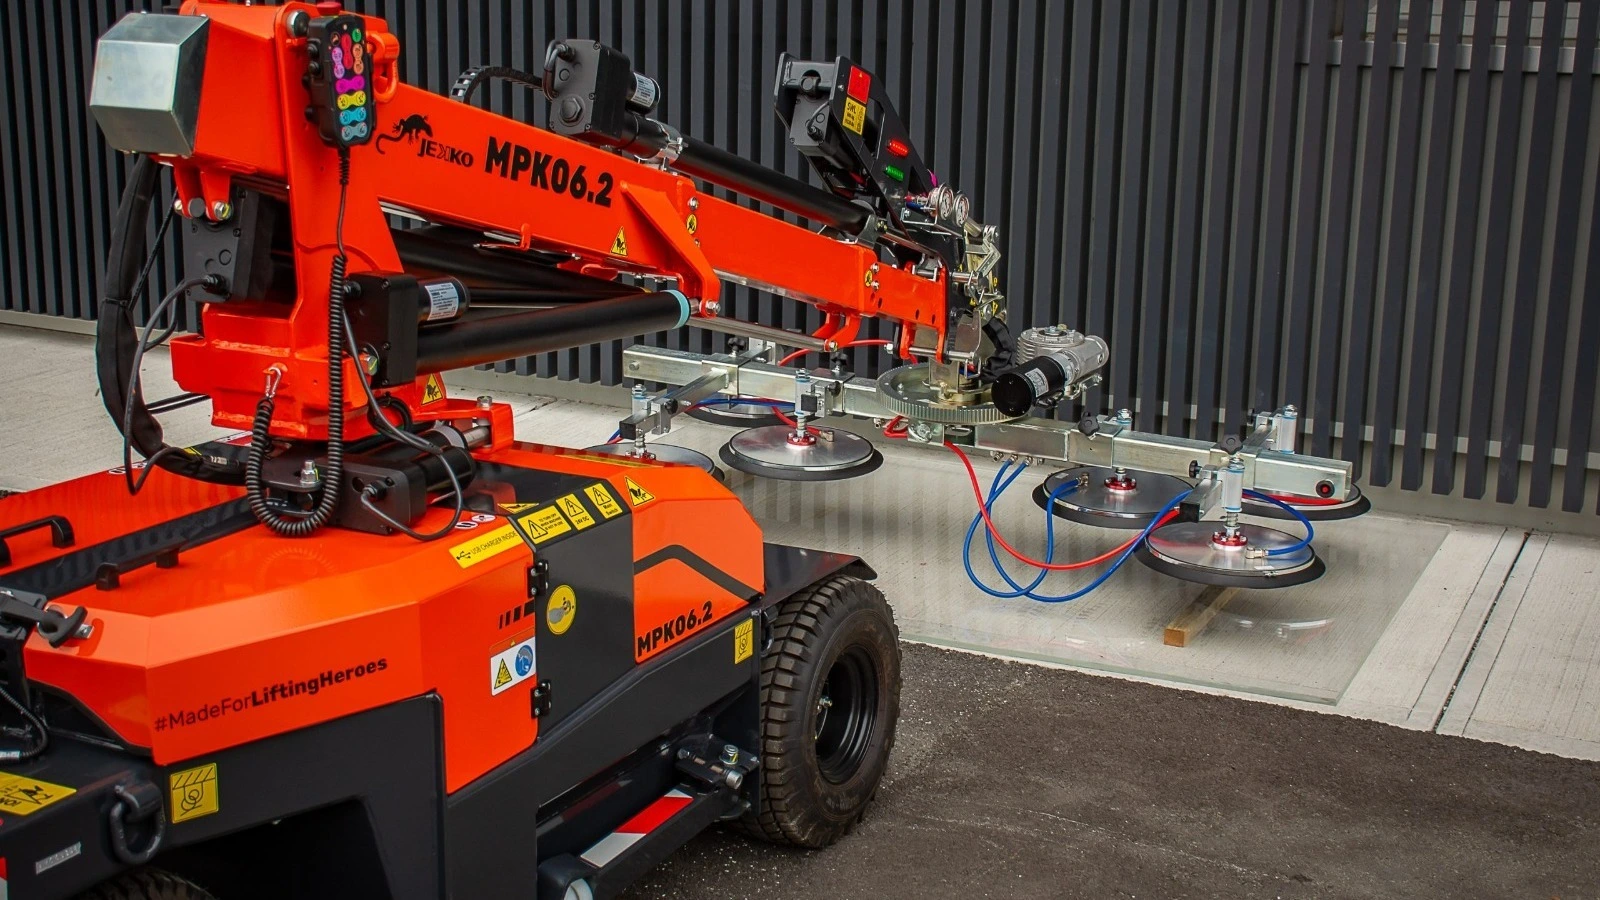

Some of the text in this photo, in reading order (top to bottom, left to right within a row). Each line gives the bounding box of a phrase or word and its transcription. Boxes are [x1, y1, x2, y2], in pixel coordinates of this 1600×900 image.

[418, 138, 474, 167] JEKKO
[484, 136, 614, 208] MPK06.2
[470, 530, 517, 555] USB CHARGER INSIDE
[638, 600, 712, 656] MPK06.2
[154, 658, 388, 732] #MadeForLiftingHeroes
